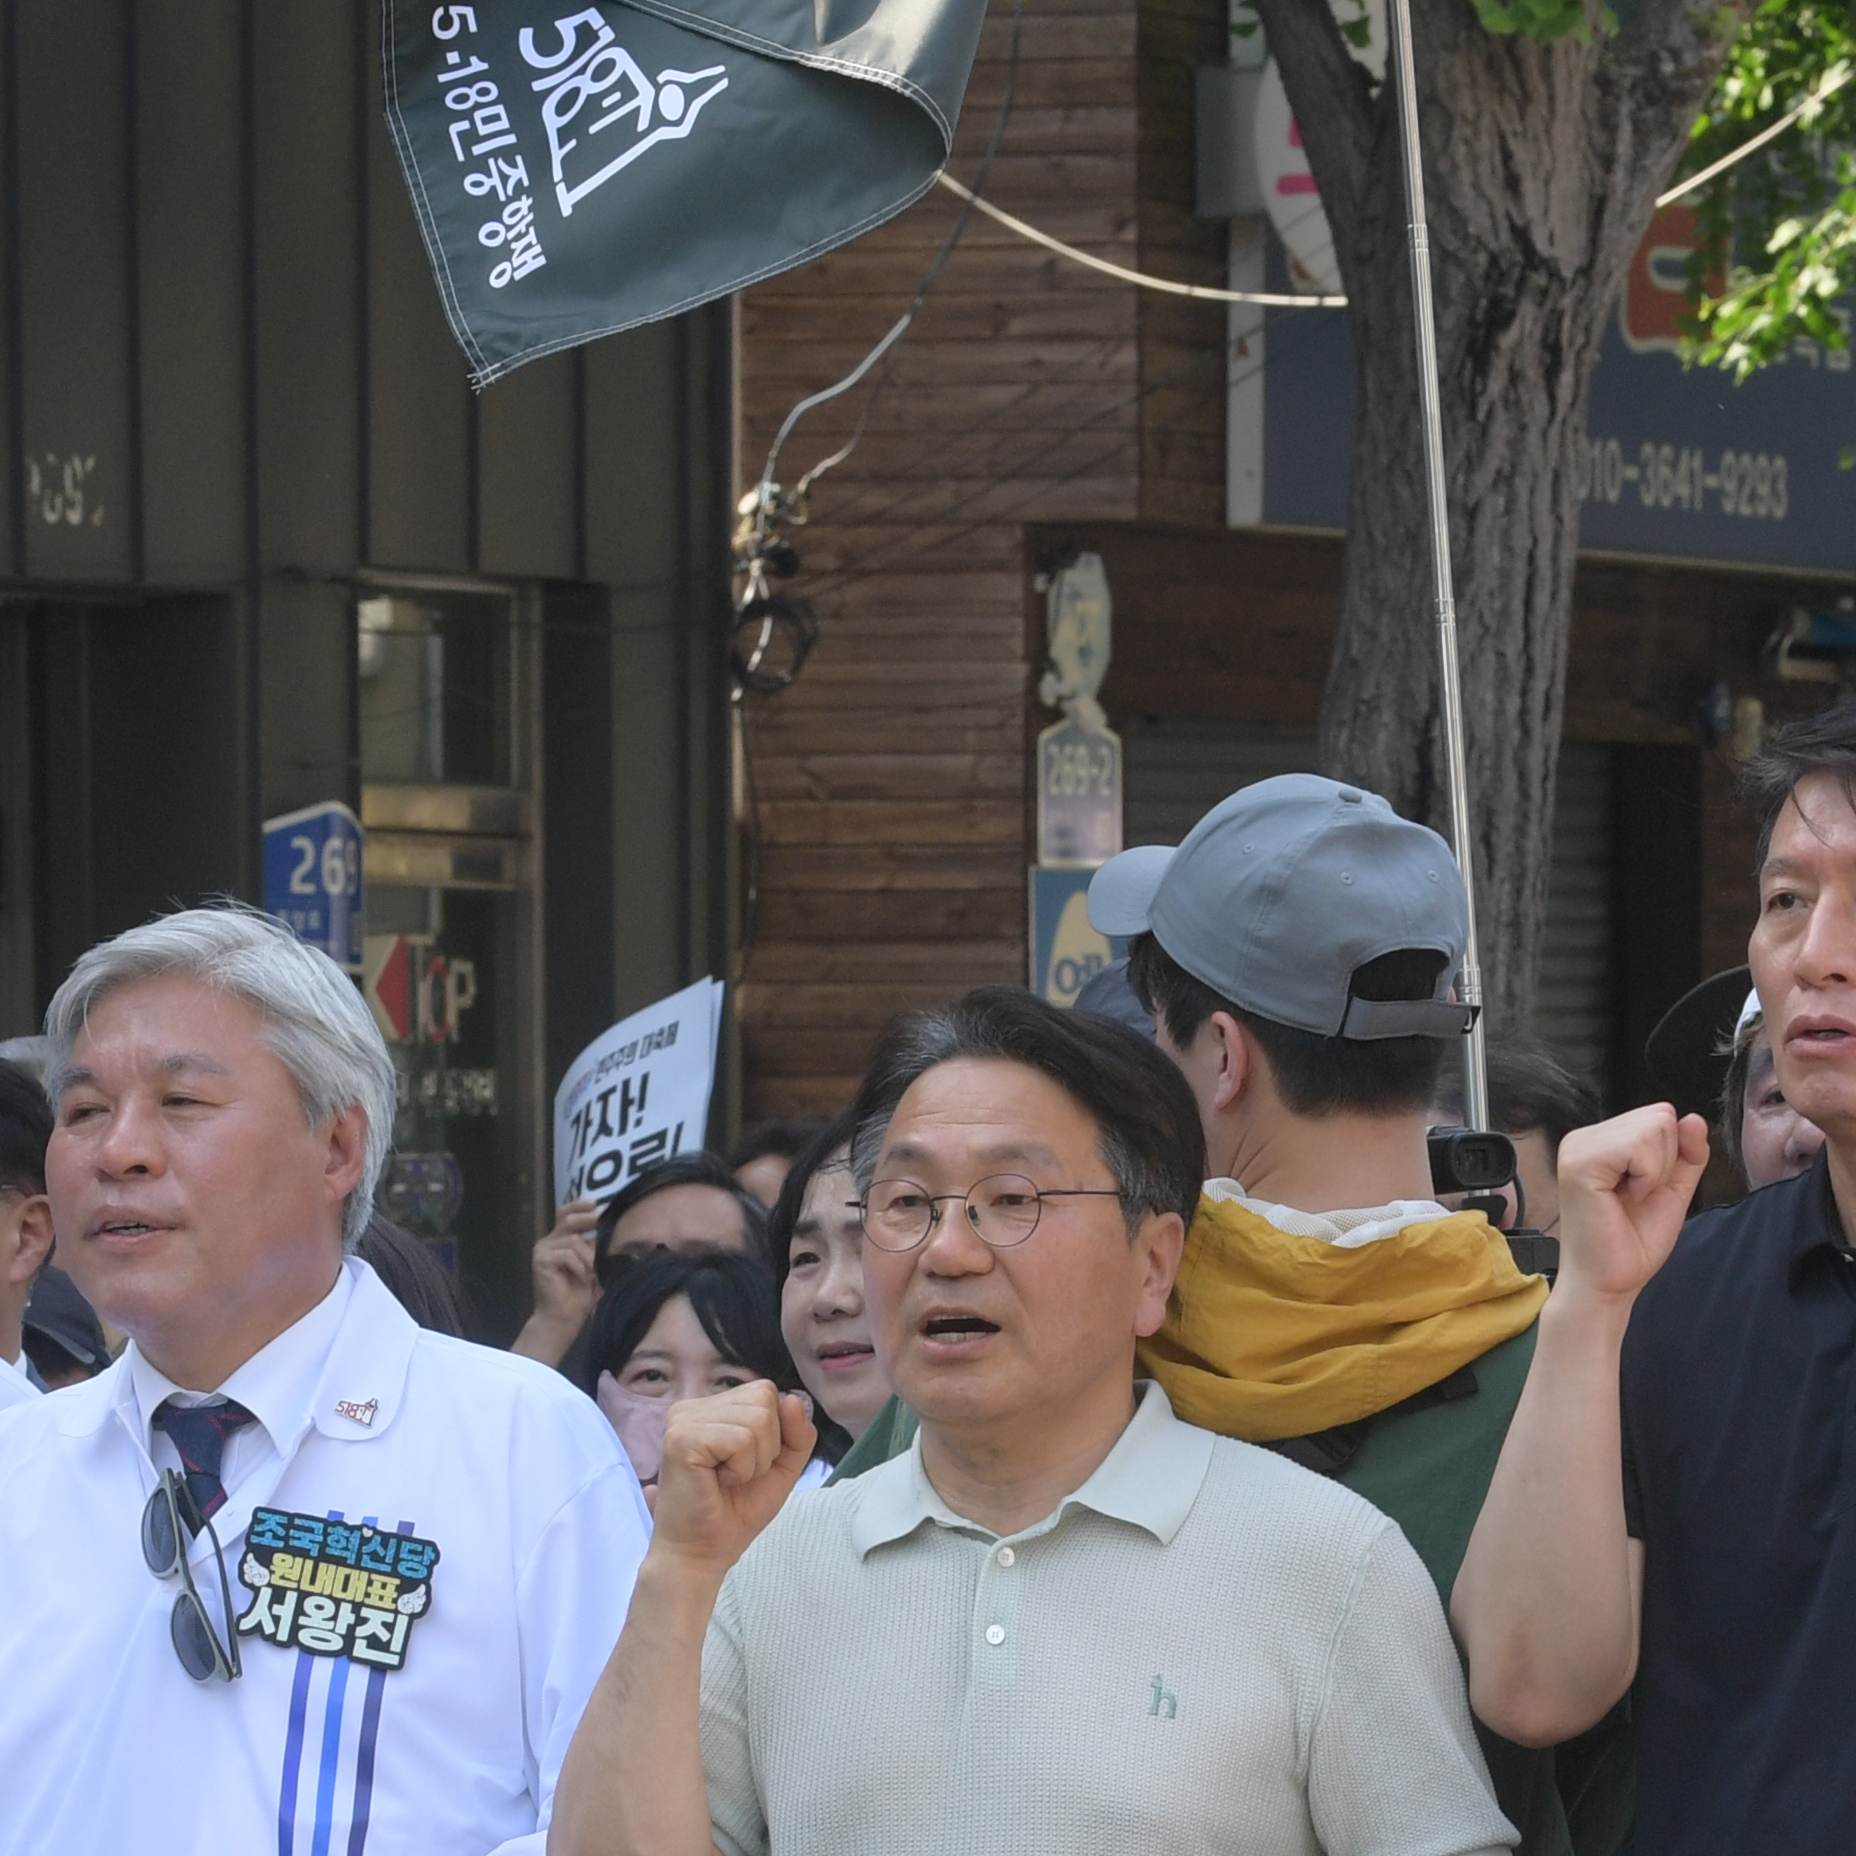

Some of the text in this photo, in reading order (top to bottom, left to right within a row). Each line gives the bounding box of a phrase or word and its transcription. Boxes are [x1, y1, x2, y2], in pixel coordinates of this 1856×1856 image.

[249, 1510, 436, 1580] 조국혁신당
[269, 1551, 401, 1611] 원내대표
[238, 1586, 410, 1667] 서왕진
